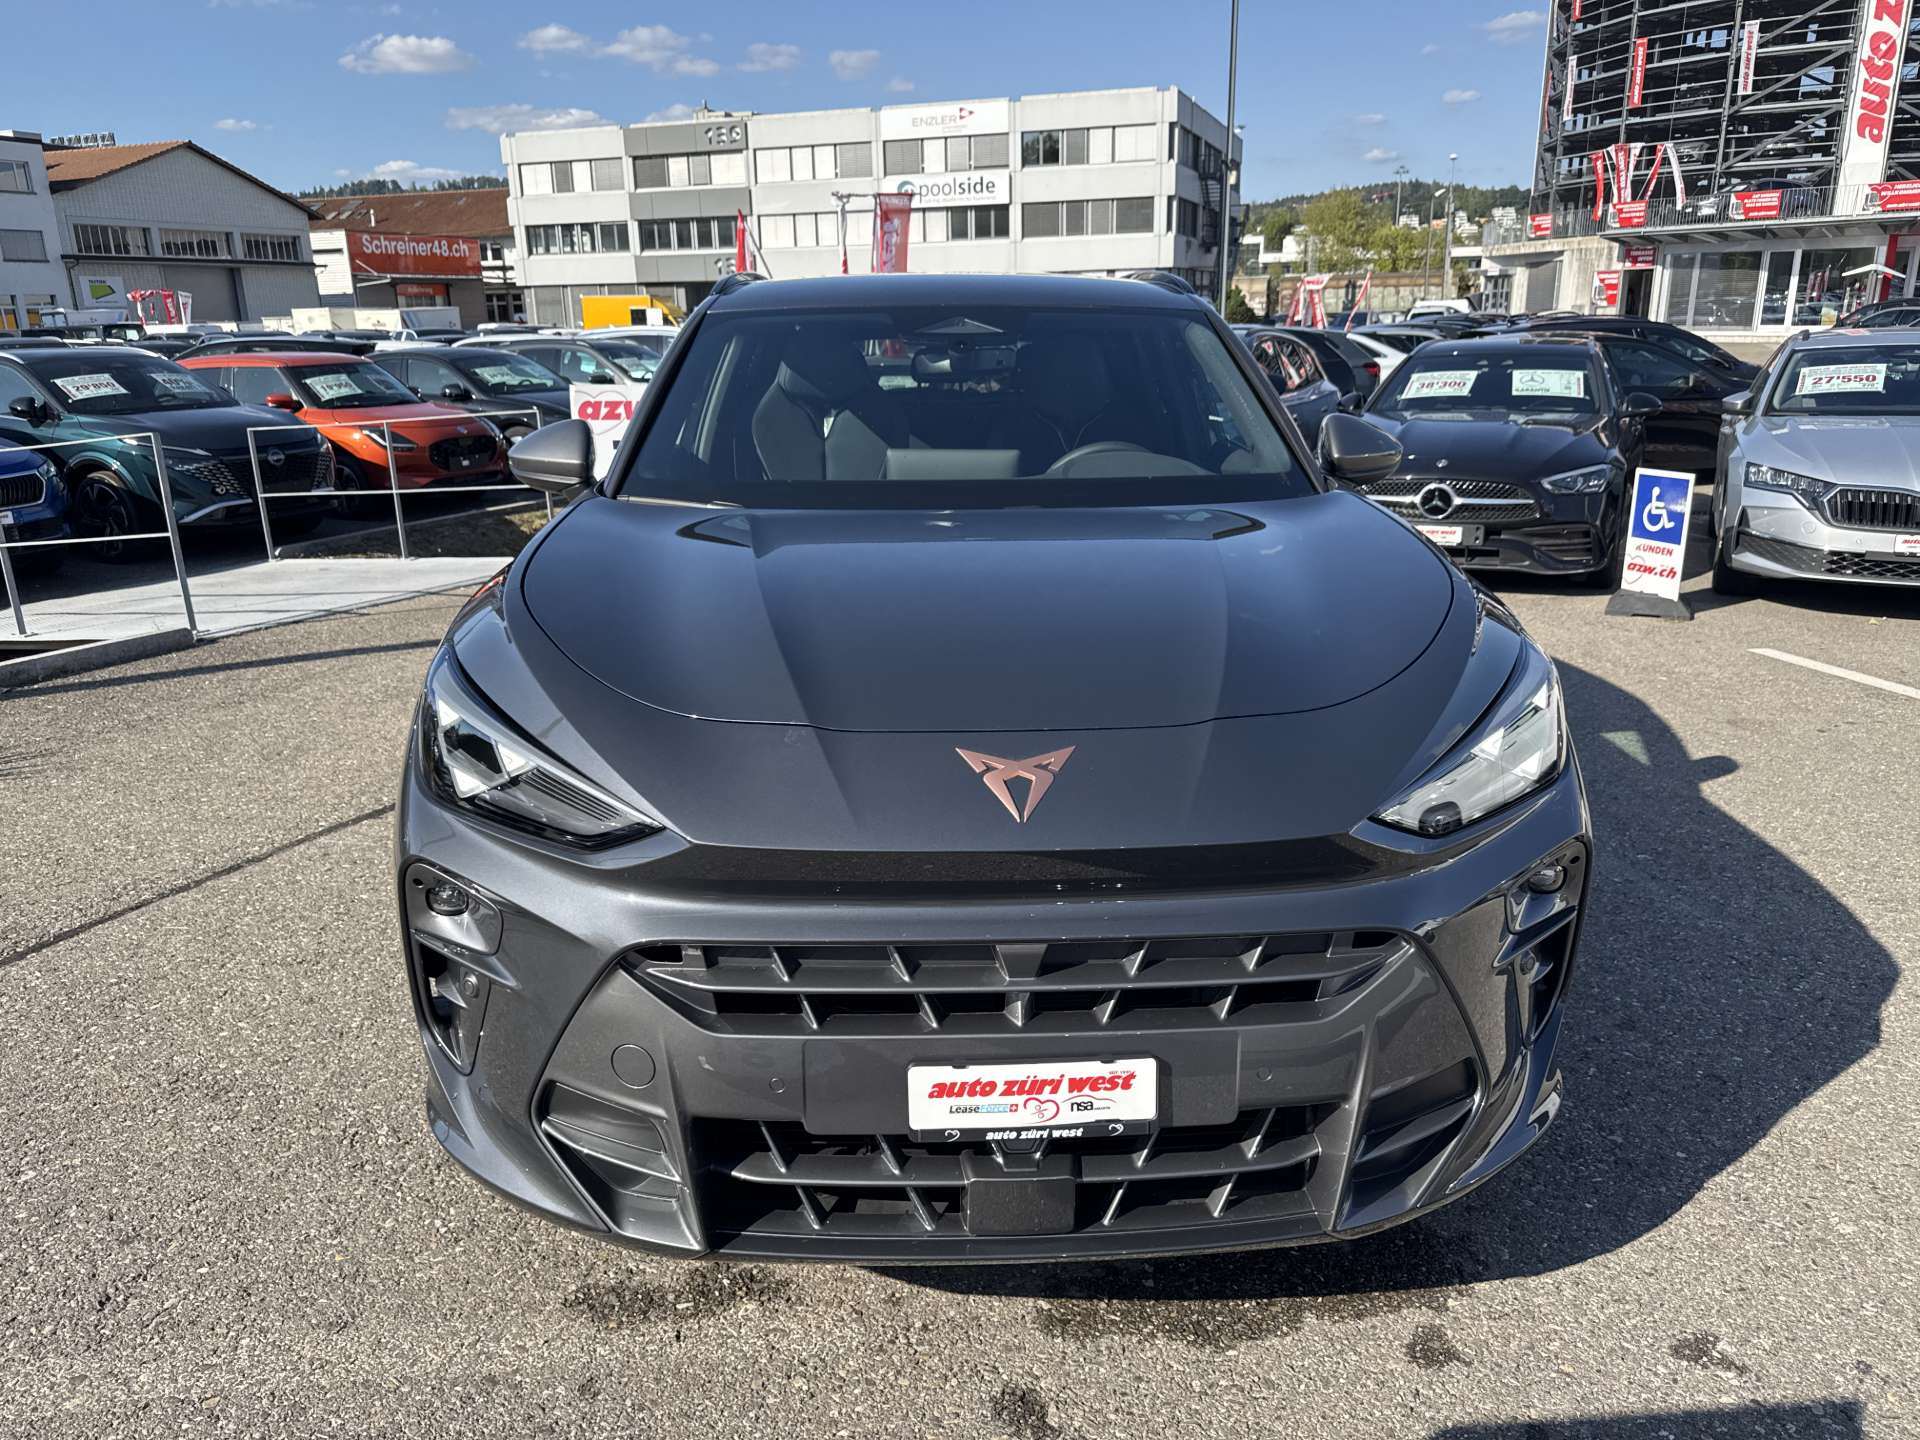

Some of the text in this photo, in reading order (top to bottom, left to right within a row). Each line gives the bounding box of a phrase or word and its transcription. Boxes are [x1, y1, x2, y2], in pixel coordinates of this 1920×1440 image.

[1857, 31, 1896, 144] auto
[912, 114, 957, 127] ENZLER
[919, 176, 996, 204] poolside
[362, 234, 469, 257] Schreiner48.ch
[1811, 374, 1877, 385] 27'550
[1635, 543, 1674, 557] KUNDEN
[1627, 562, 1677, 579] azw.ch
[928, 1071, 1137, 1099] auto züri west
[949, 1101, 1094, 1114] LeaseForce nsa
[986, 1127, 1083, 1140] auto züri west
